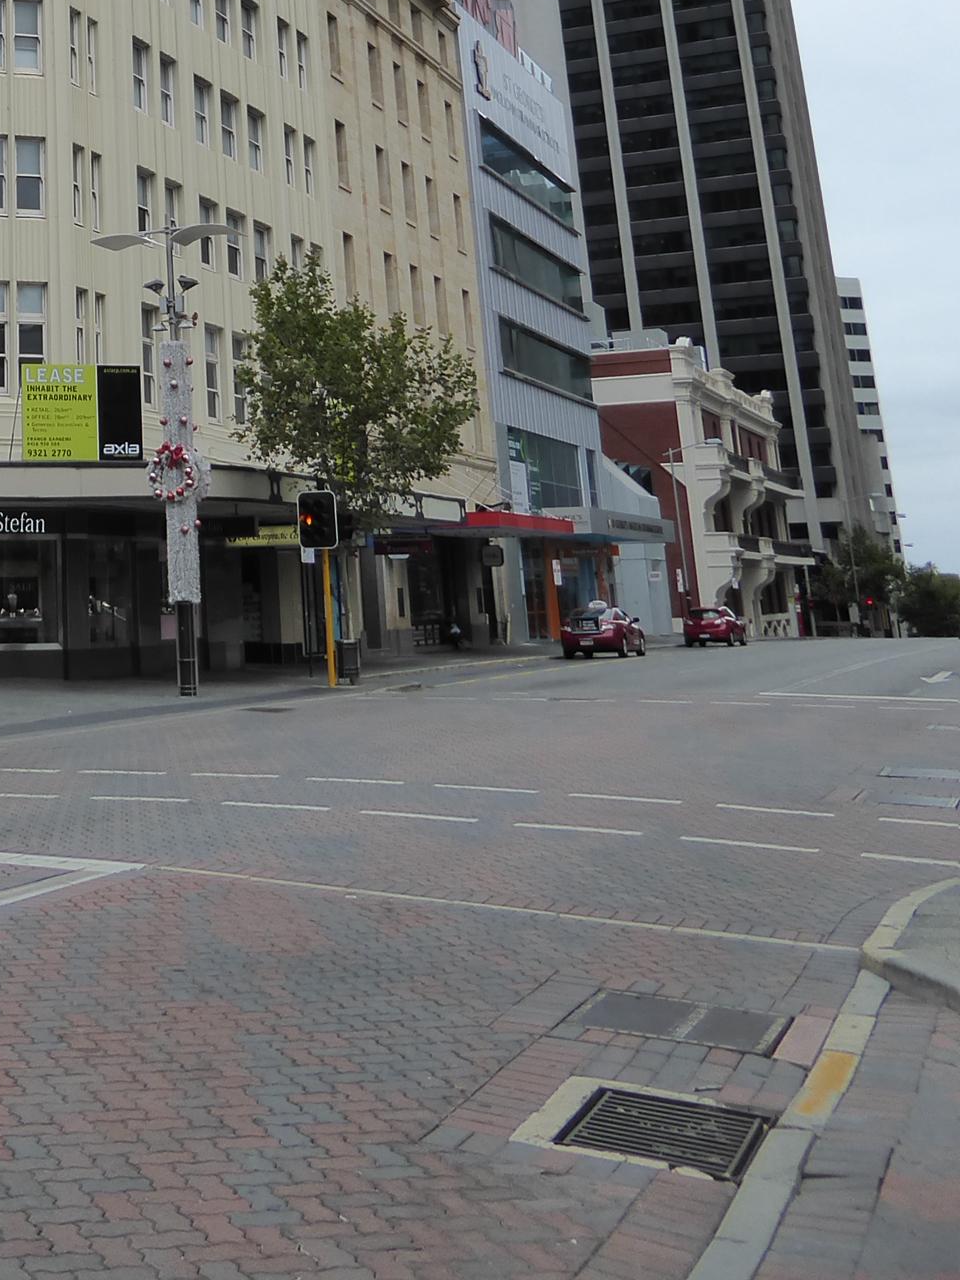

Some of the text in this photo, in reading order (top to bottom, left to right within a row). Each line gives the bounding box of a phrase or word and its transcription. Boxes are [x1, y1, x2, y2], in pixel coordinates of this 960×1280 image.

[25, 368, 85, 383] LEASE
[27, 449, 72, 457] 9321 2770
